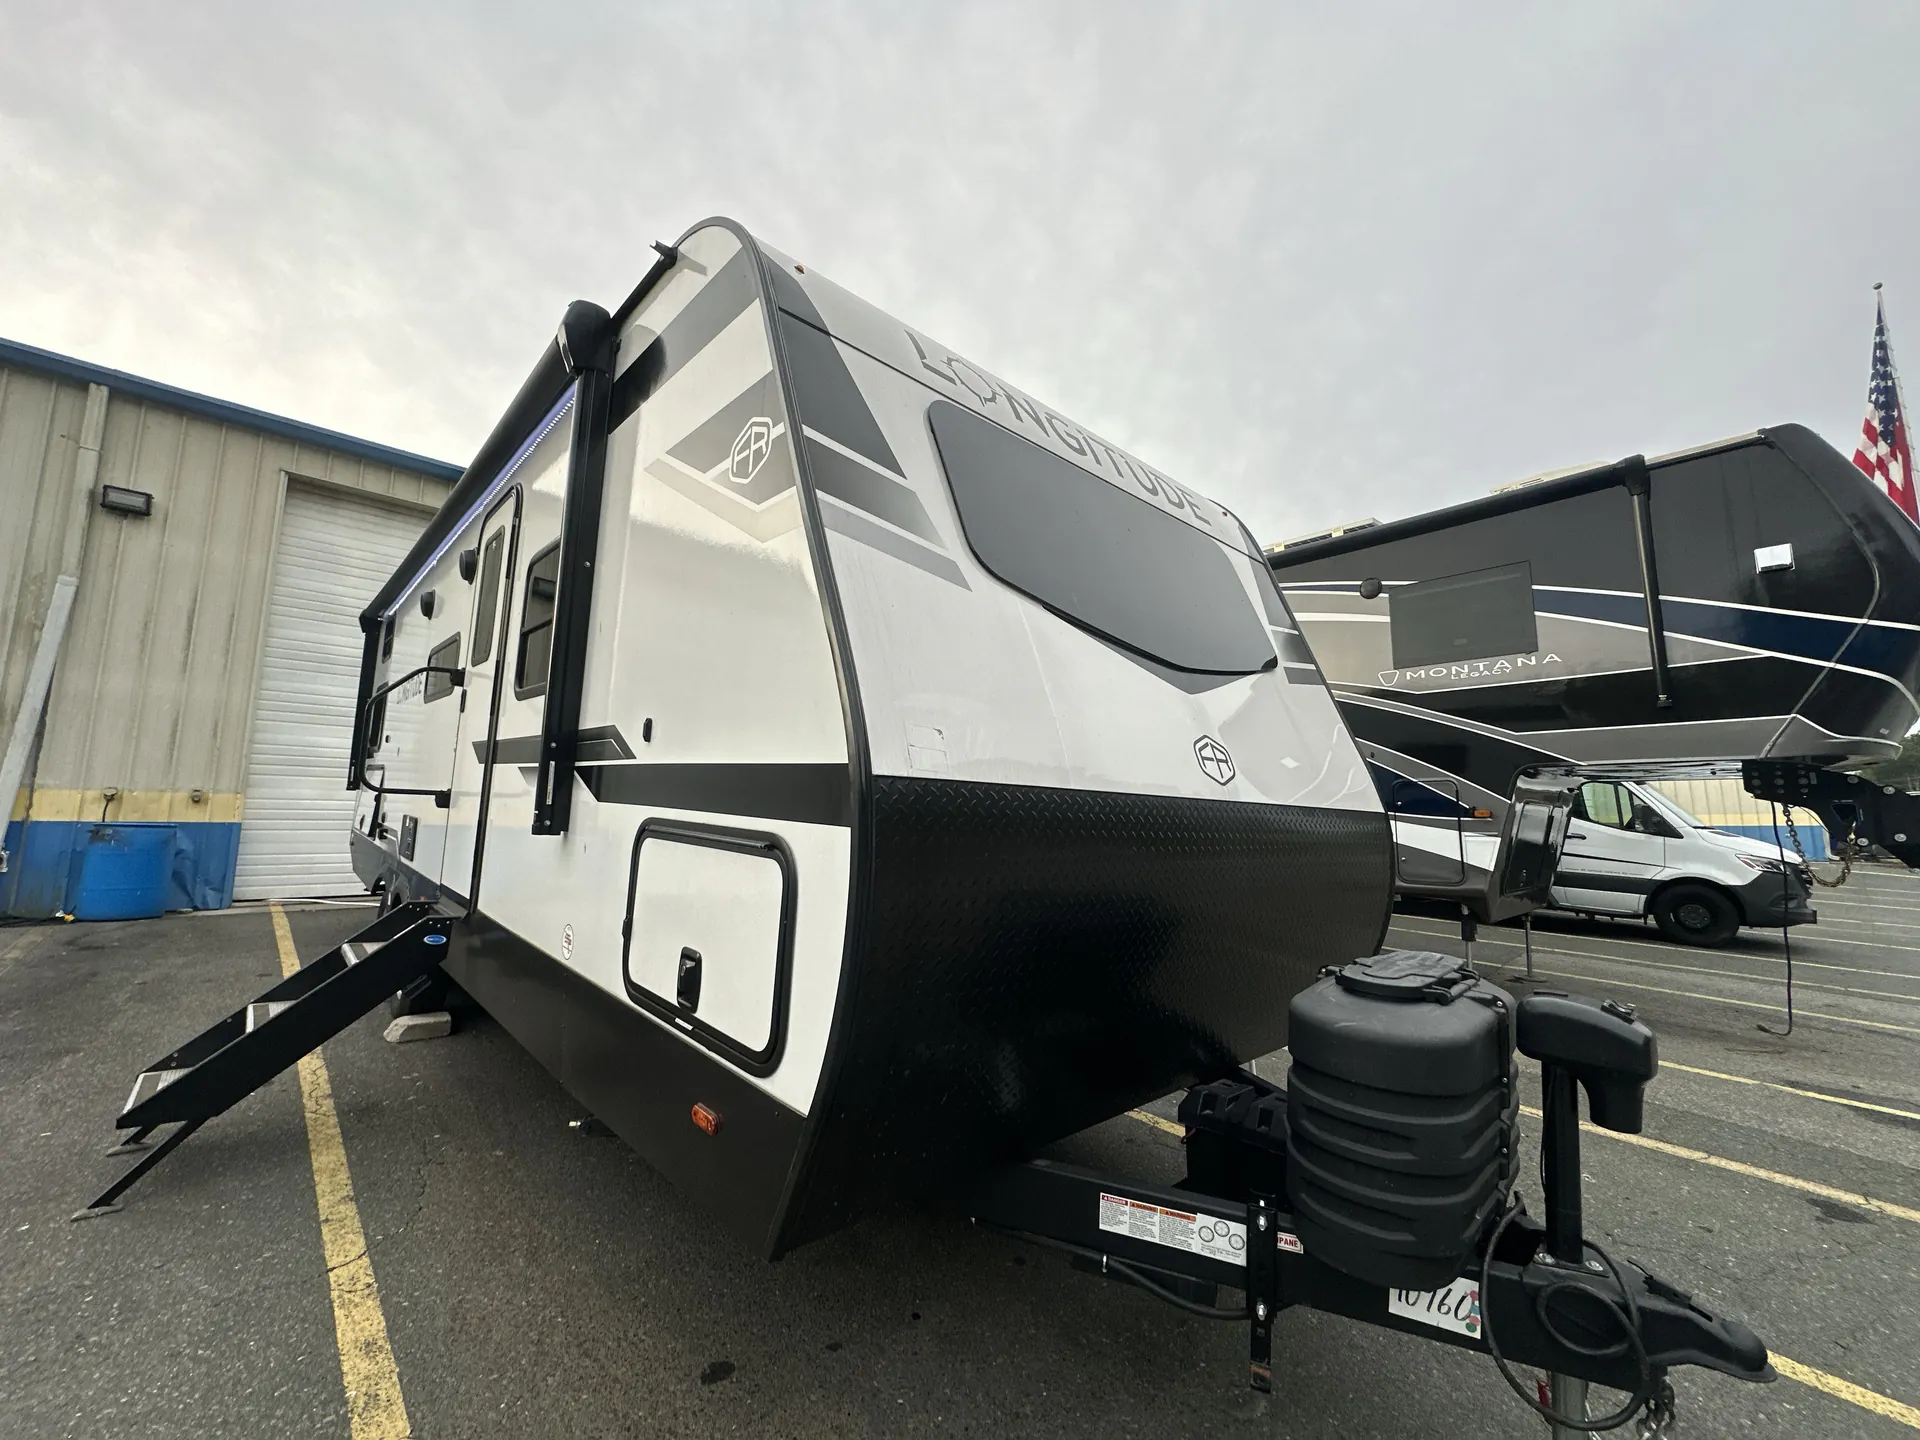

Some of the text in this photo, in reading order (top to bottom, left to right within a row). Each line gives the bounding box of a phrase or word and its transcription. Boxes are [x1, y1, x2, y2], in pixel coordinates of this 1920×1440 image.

[904, 329, 1212, 526] LONGITUDE
[1405, 653, 1562, 681] MONTANA
[1450, 667, 1513, 680] LEGACY
